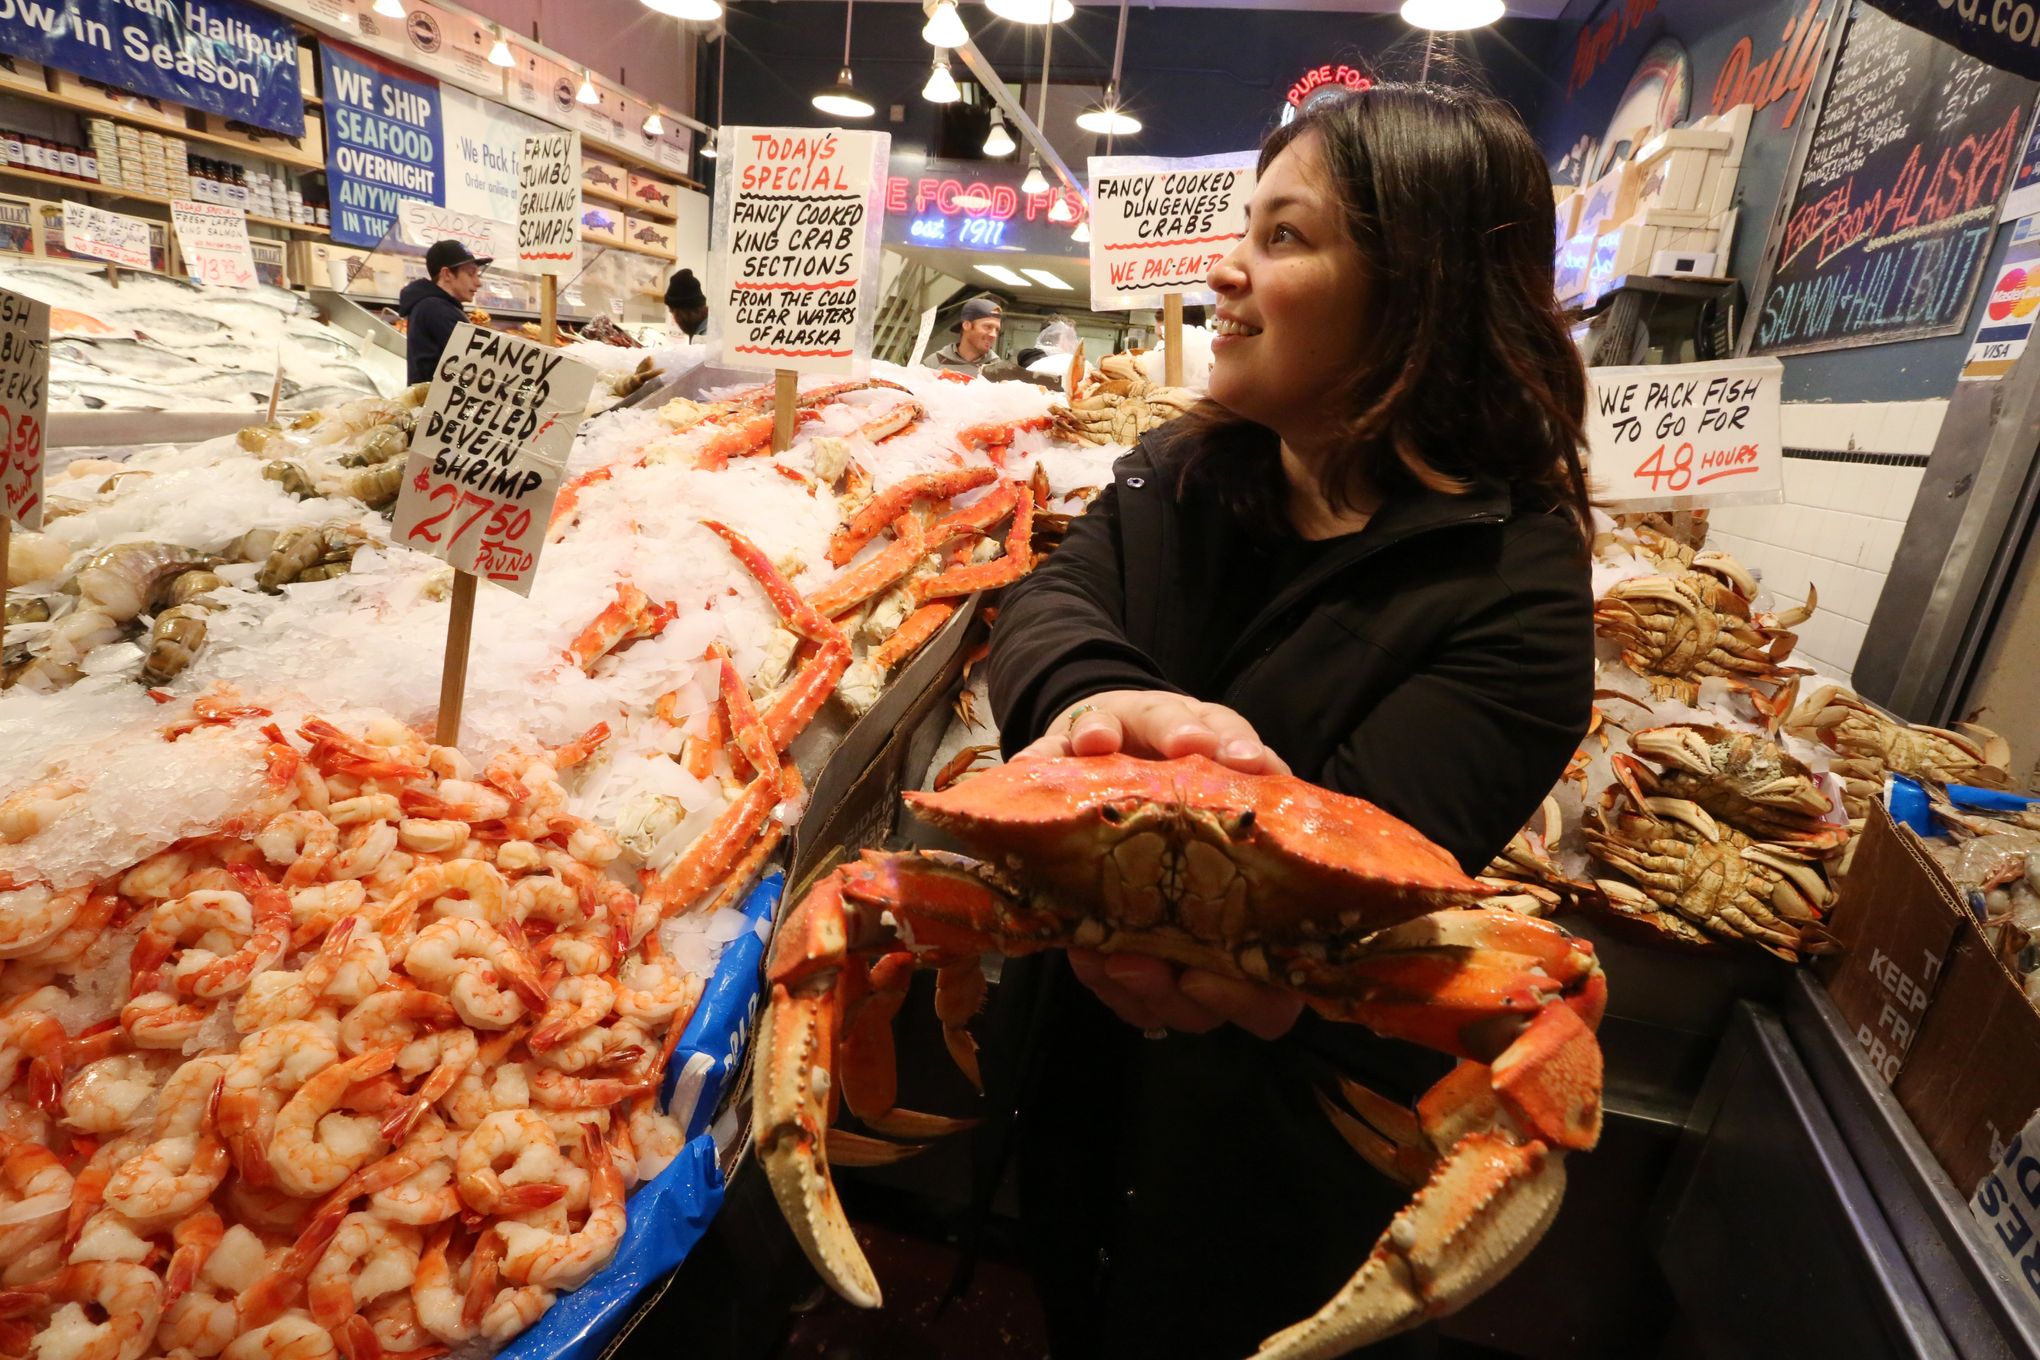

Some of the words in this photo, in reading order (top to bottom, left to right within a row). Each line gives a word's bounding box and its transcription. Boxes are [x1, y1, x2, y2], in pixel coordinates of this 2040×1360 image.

[69, 6, 112, 51] in
[122, 26, 260, 97] Season
[333, 66, 374, 111] WE
[382, 84, 431, 127] SHIP
[1288, 65, 1332, 105] PURE
[336, 109, 433, 163] SEAFOOD
[523, 133, 572, 166] FANCY
[752, 133, 838, 168] TODAY'S
[336, 147, 435, 194] OVERNIGHT
[460, 136, 479, 163] We
[483, 144, 508, 173] Pack
[465, 172, 486, 190] Order
[520, 163, 571, 189] JUMBO
[742, 165, 849, 191] SPECIAL
[1098, 176, 1155, 201] FANCY
[1818, 189, 1882, 263] FROM
[1878, 104, 2021, 233] ALASKA
[520, 188, 576, 215] GRILLING
[916, 178, 1018, 220] FOOD
[1123, 193, 1231, 218] DUNGENESS
[342, 211, 360, 233] IN
[518, 217, 574, 247] SCAMPIS
[733, 202, 793, 236] FANCY
[796, 203, 864, 226] COOKED
[911, 217, 946, 239] est.
[958, 217, 1004, 245] 1911
[1138, 214, 1214, 238] CRABS
[1782, 176, 1854, 268] FRESH
[732, 229, 779, 254] KING
[788, 228, 853, 251] CRAB
[743, 253, 853, 277] SECTIONS
[1110, 260, 1138, 285] WE
[729, 289, 773, 307] FROM
[780, 291, 814, 308] THE
[817, 288, 857, 307] COLD
[1760, 265, 1850, 346] SALMON
[736, 307, 791, 326] CLEAR
[796, 307, 857, 326] WATERS
[749, 325, 773, 342] OF
[770, 328, 842, 346] ALASKA
[1982, 343, 2010, 360] VISA
[465, 327, 563, 385] FANCY
[440, 355, 551, 409] COOKED
[1598, 384, 1638, 417] WE
[1645, 380, 1699, 412] PACK
[1703, 377, 1763, 406] FISH
[443, 385, 538, 441] PEELED
[1612, 416, 1642, 444] TO
[1656, 412, 1686, 439] GO
[1698, 405, 1750, 434] FOR
[425, 410, 525, 468] DEVEIN
[432, 447, 543, 501] SHRIMP
[1633, 442, 1694, 492] 48
[1700, 443, 1759, 470] HOURS
[485, 503, 533, 542] 50
[472, 545, 534, 573] POUND
[1868, 947, 1928, 1013] KEEP
